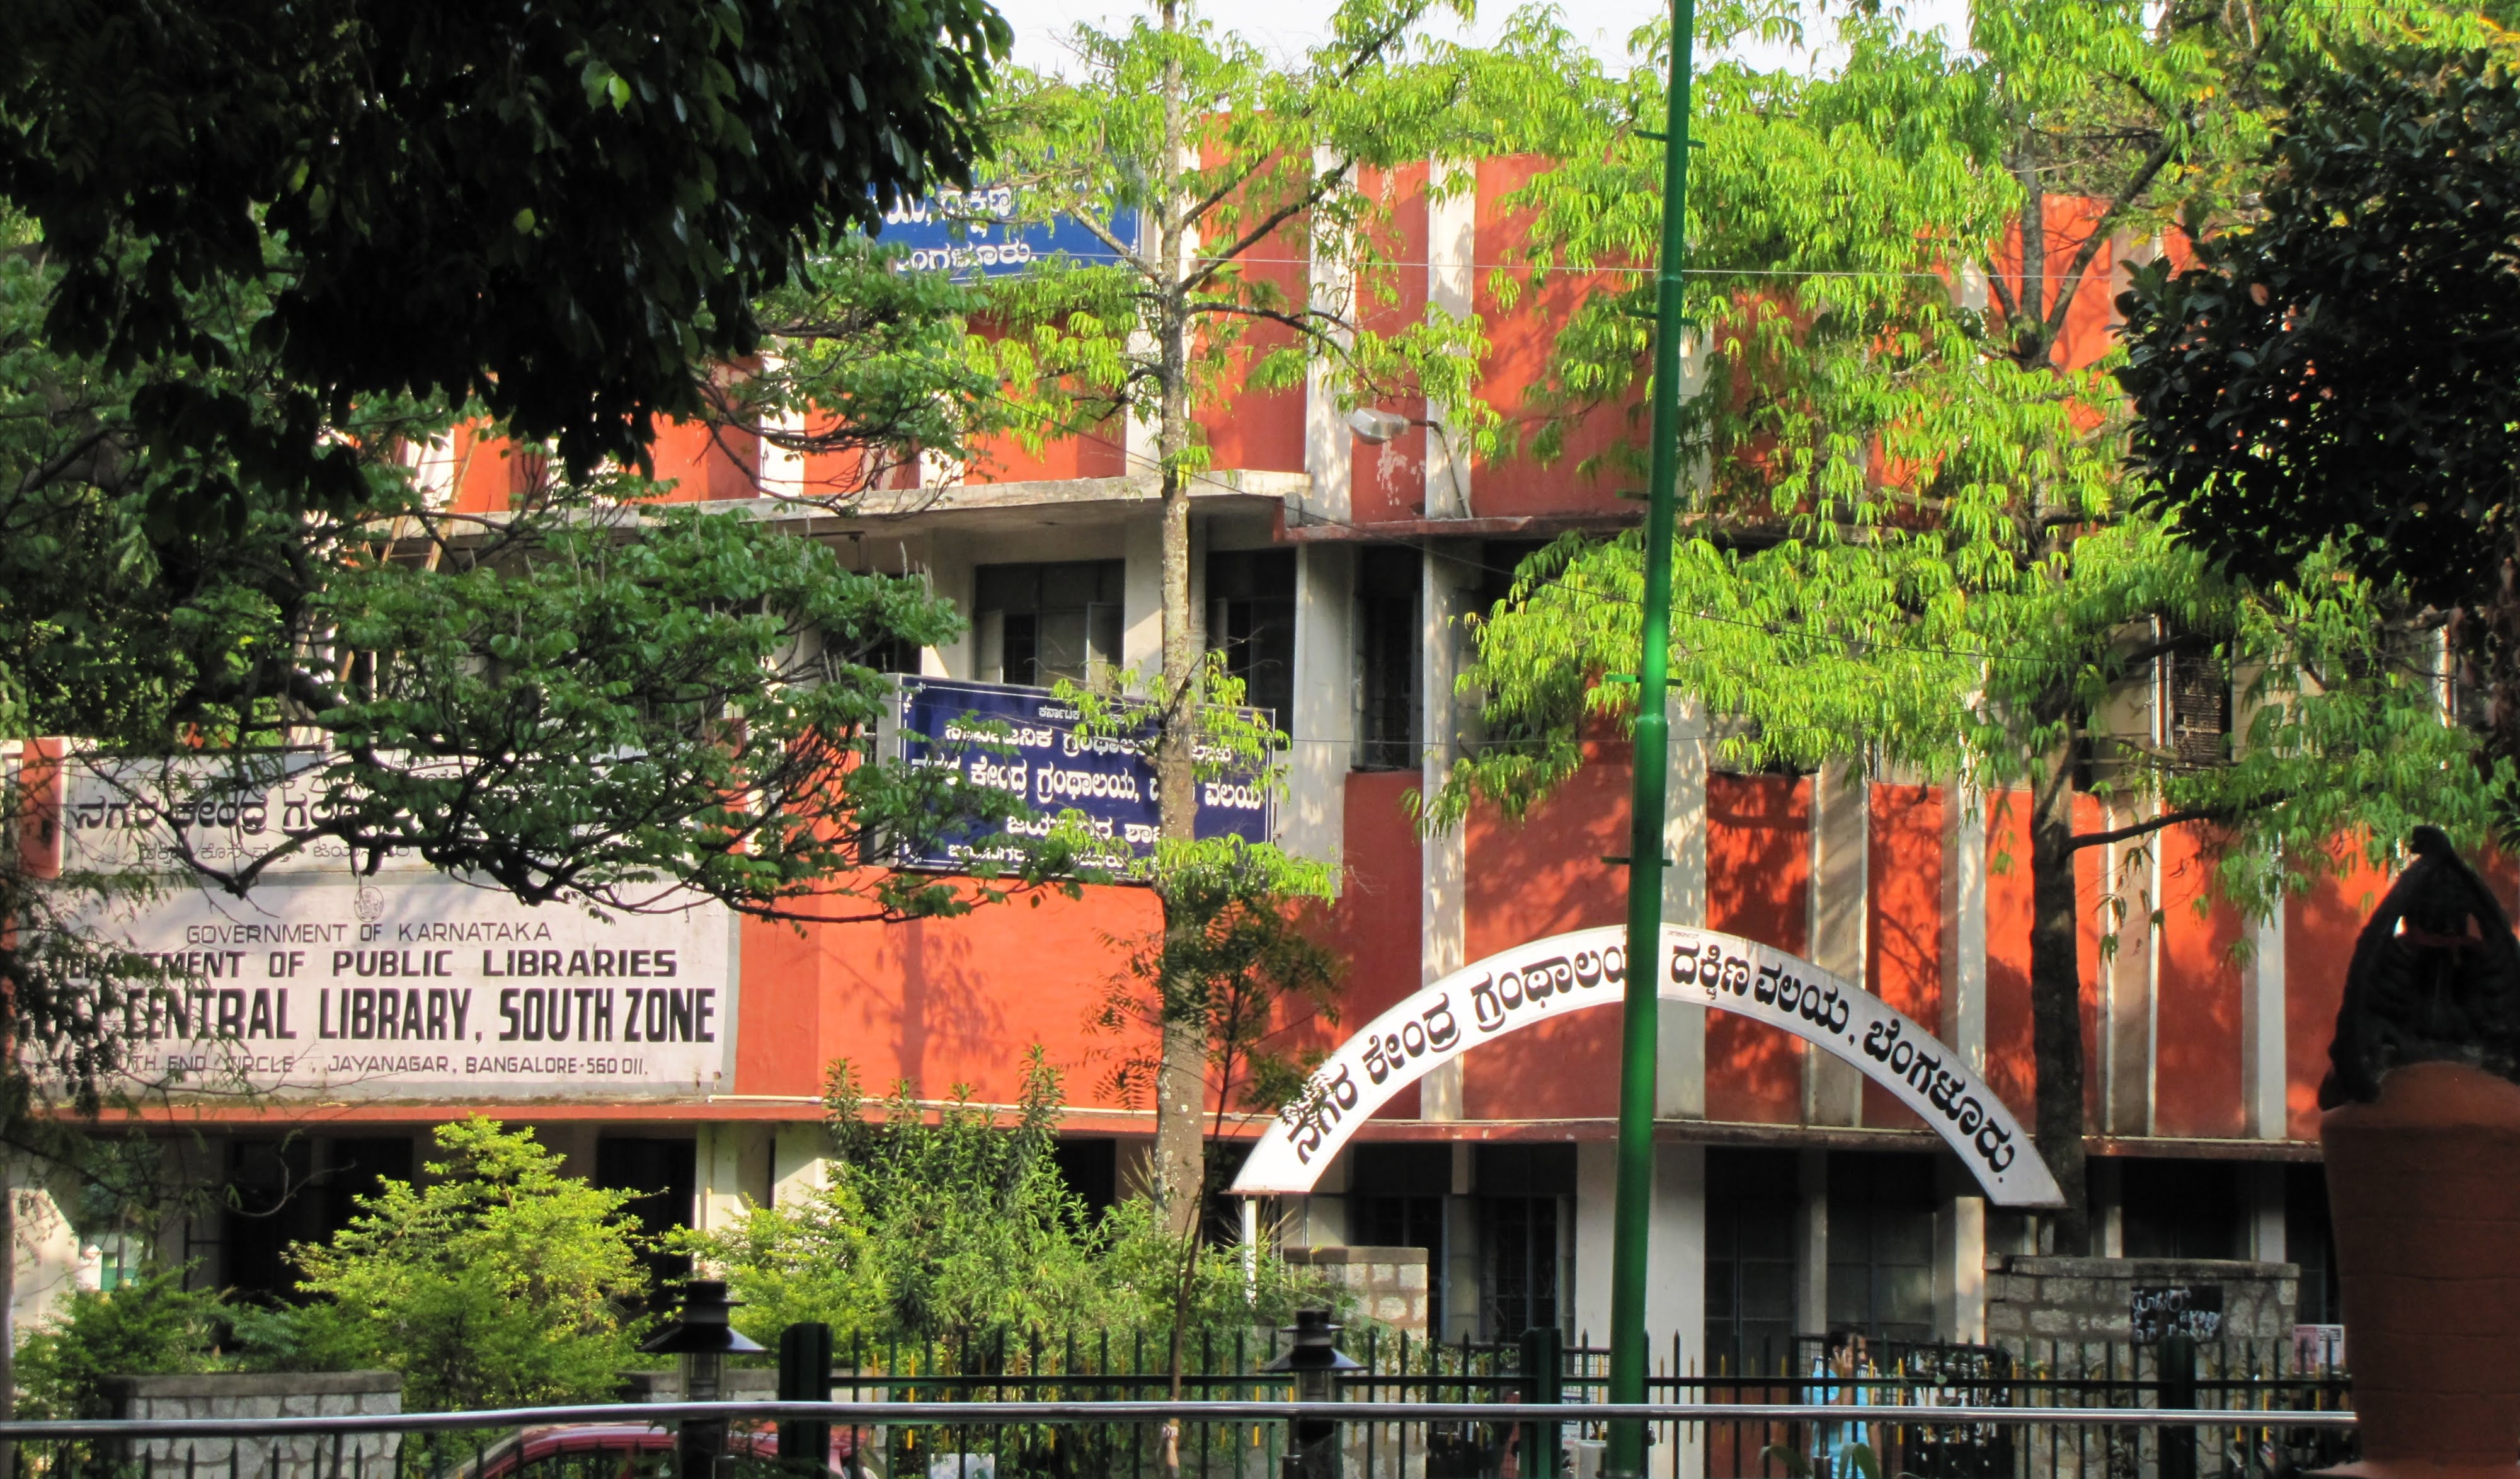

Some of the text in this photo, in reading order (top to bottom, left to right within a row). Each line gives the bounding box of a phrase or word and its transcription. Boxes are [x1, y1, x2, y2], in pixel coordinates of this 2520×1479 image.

[896, 238, 1037, 272] ಂಗಳೂರು.
[186, 922, 552, 943] GOVERNMENT OF KARNATAKA
[268, 951, 306, 978] OF
[333, 950, 453, 977] PUBLIC
[483, 949, 677, 977] LIBRARIES
[127, 987, 297, 1040] CENTRAL
[319, 987, 483, 1044] LIBRARY,
[499, 987, 614, 1042] SOUTH
[624, 987, 716, 1042] ZONE
[1286, 1063, 1358, 1165] ನಗರ
[1361, 993, 1461, 1085] ಕೇಂದ್ರ
[1671, 941, 1750, 1000] ದಕ್ಷಿಣ
